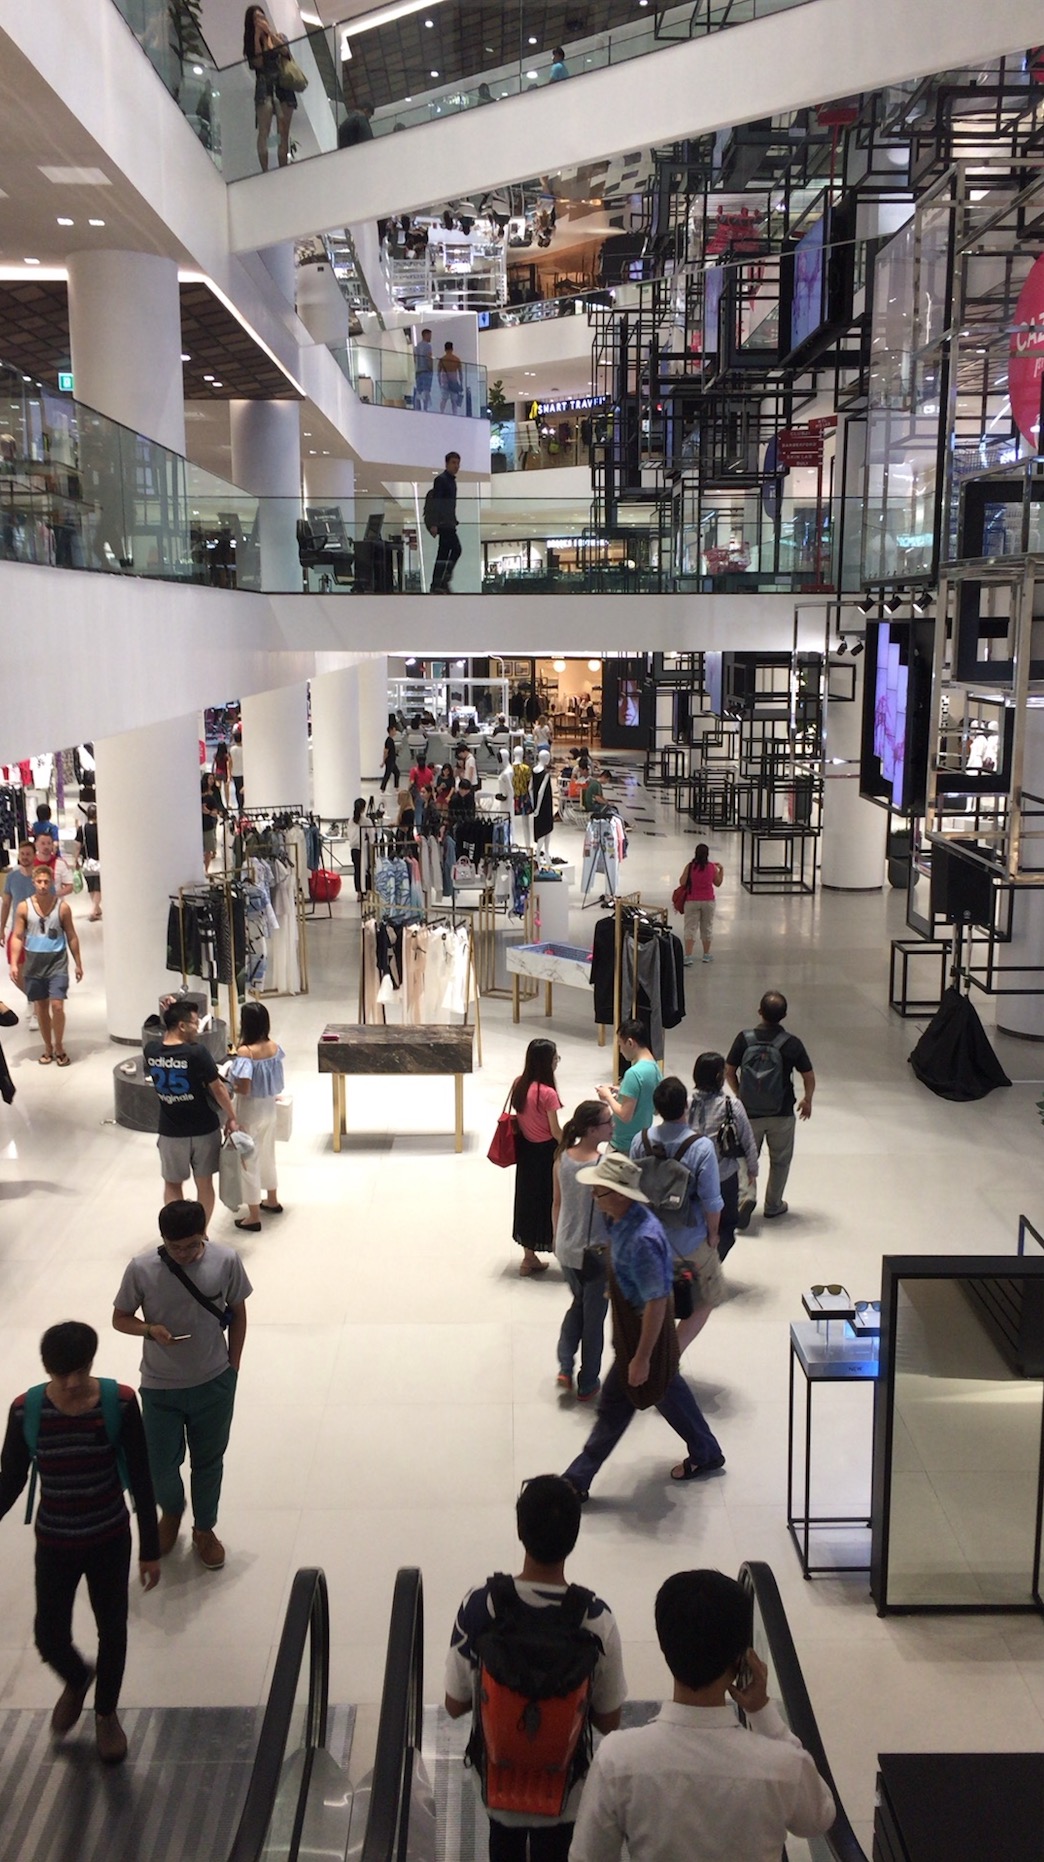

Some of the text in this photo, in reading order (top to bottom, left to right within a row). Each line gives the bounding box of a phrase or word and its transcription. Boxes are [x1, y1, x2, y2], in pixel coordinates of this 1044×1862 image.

[537, 401, 567, 415] SMART
[148, 1056, 188, 1069] adidas
[151, 1067, 190, 1095] 25
[158, 1093, 194, 1105] riginals
